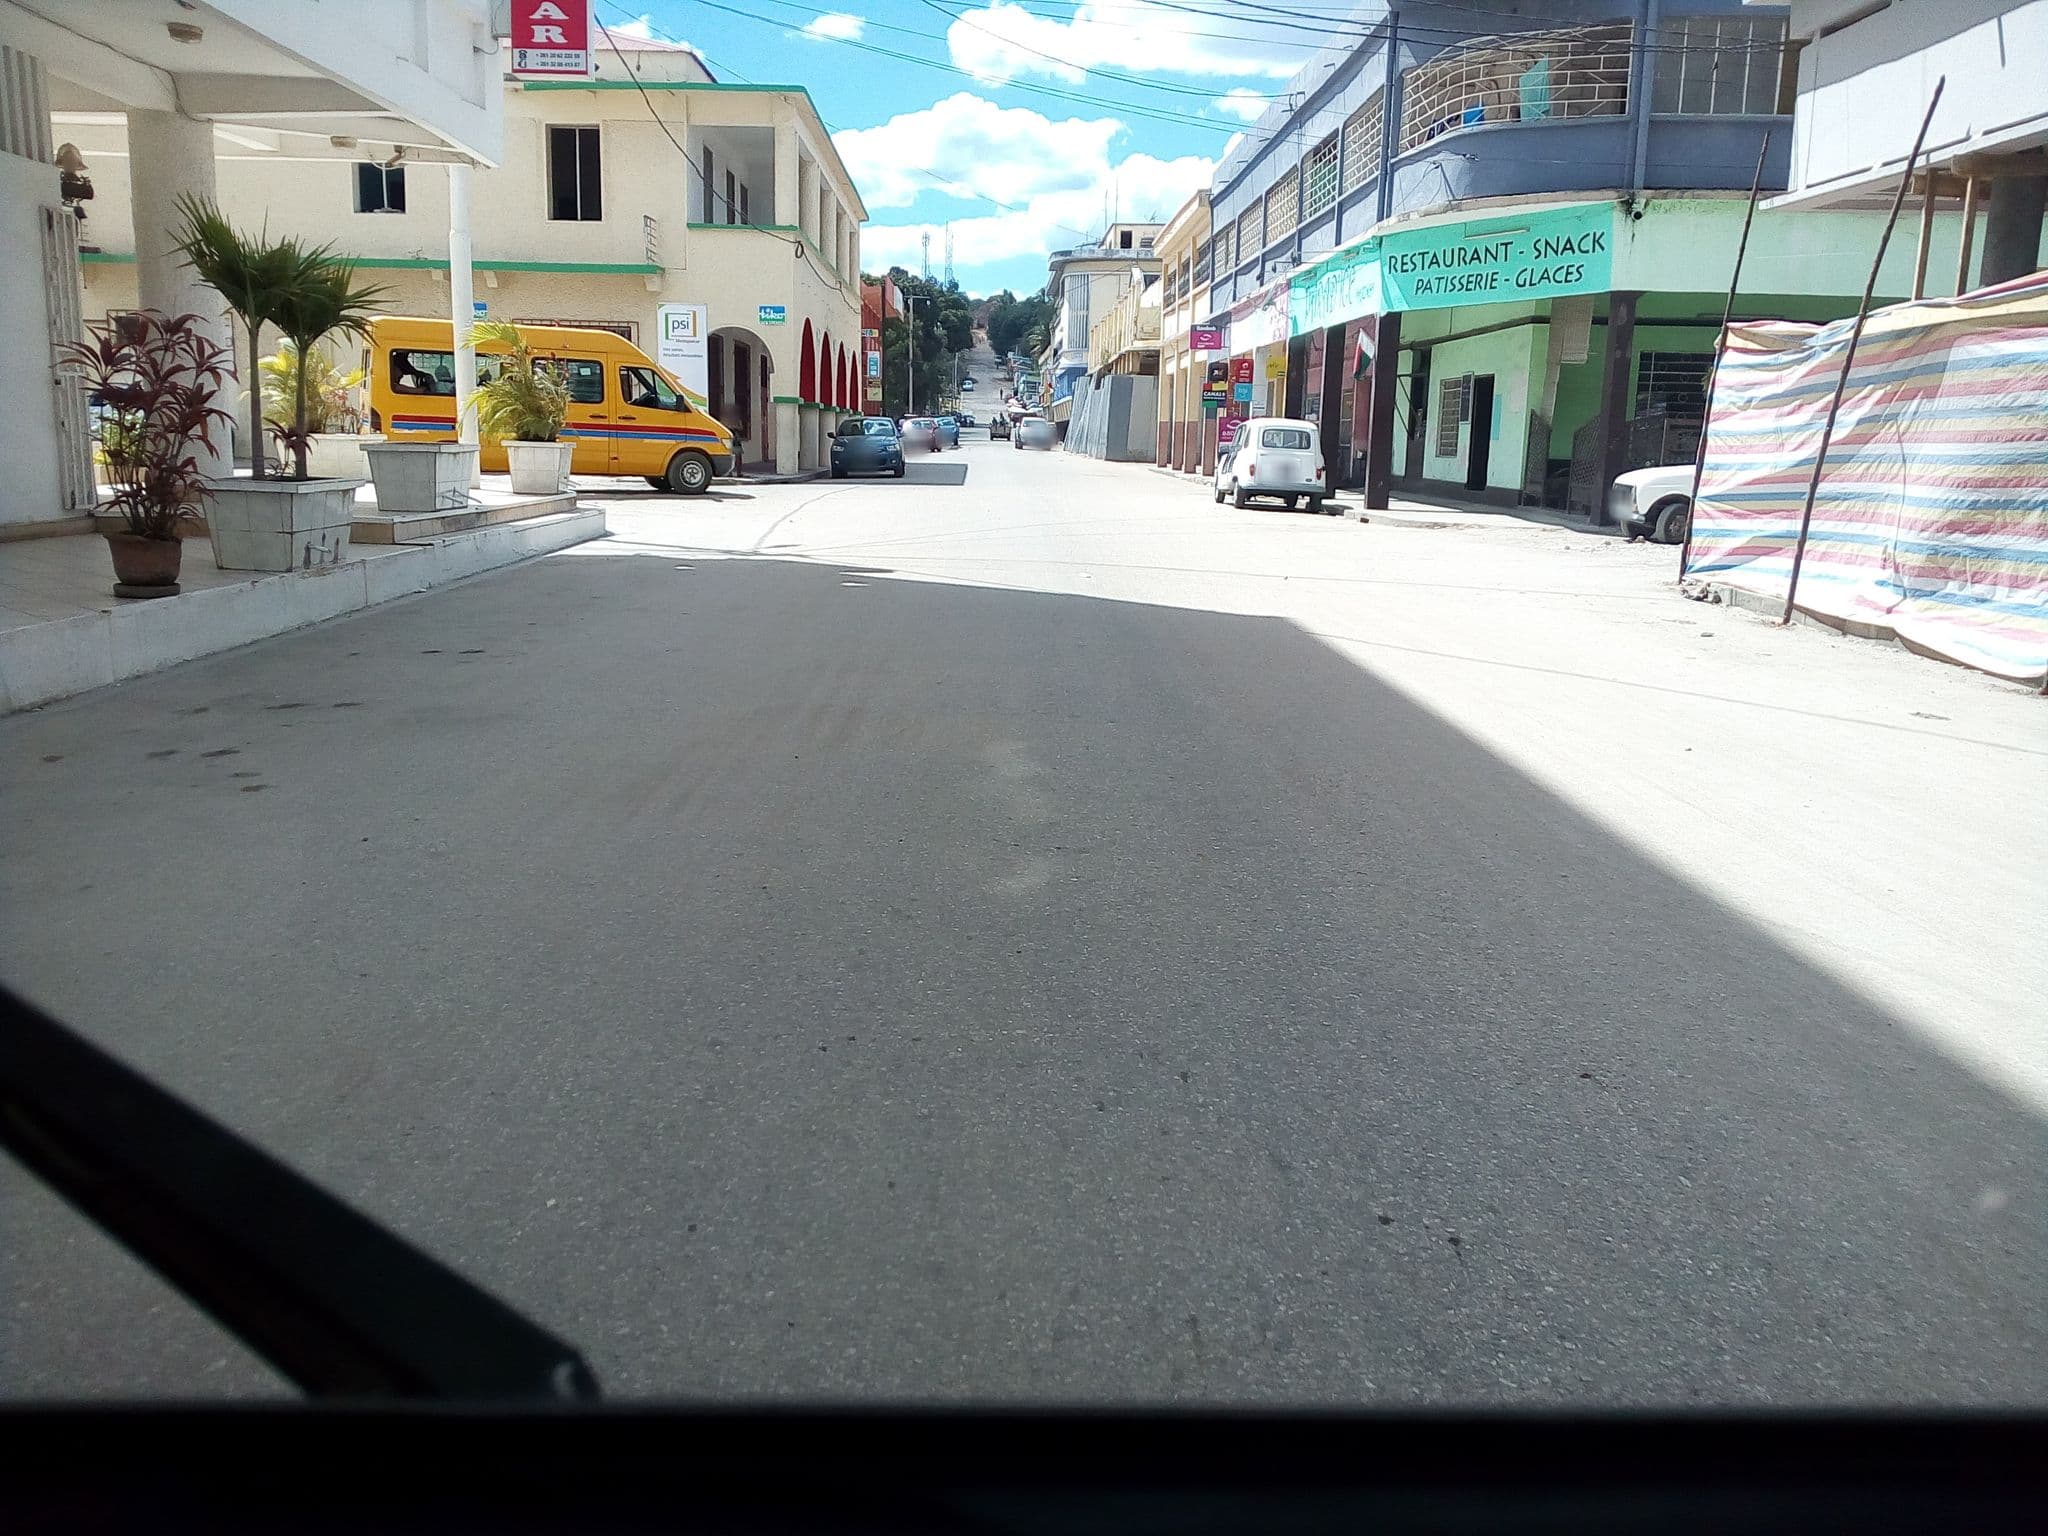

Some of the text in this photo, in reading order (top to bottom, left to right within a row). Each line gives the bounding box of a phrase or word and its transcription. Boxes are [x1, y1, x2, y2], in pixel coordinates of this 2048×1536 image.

[1388, 241, 1513, 275] RESTAURANT
[1533, 231, 1606, 260] SNACK
[1414, 271, 1499, 296] PATISSERIE
[1515, 264, 1585, 288] GLACES
[672, 316, 690, 333] psi
